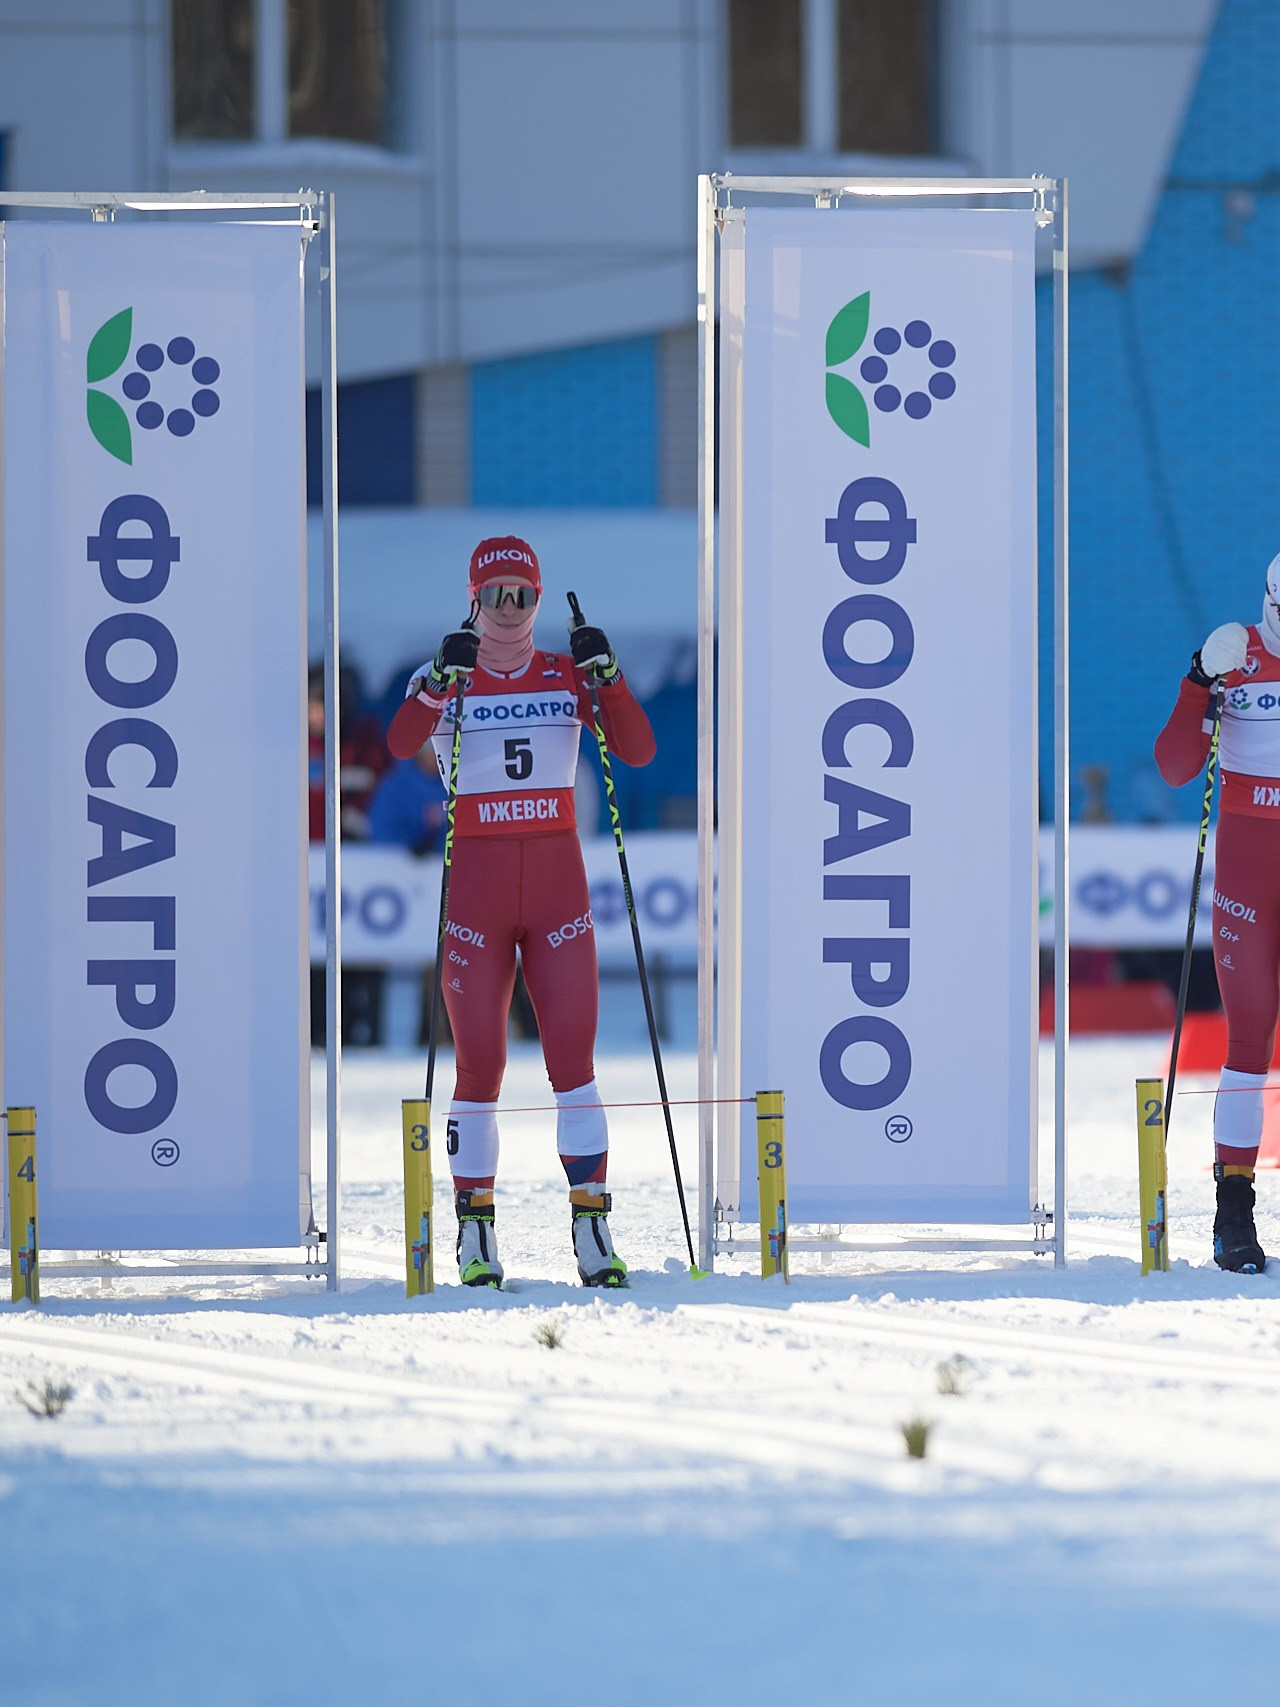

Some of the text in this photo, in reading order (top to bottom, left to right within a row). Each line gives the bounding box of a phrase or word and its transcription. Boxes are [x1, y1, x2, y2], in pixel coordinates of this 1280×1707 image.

[478, 550, 534, 569] LUKOIL
[473, 701, 575, 721] ФОСАГРО
[505, 738, 534, 780] 5
[820, 477, 917, 1111] ФОСАГРО
[84, 494, 180, 1135] ФОСАГРО
[478, 798, 559, 823] ИЖЕВСК
[1213, 889, 1257, 923] LUKOIL
[1144, 1099, 1163, 1127] 2
[410, 1124, 429, 1152] 3
[446, 1119, 459, 1156] 5
[17, 1155, 35, 1183] 4
[764, 1141, 783, 1169] 3
